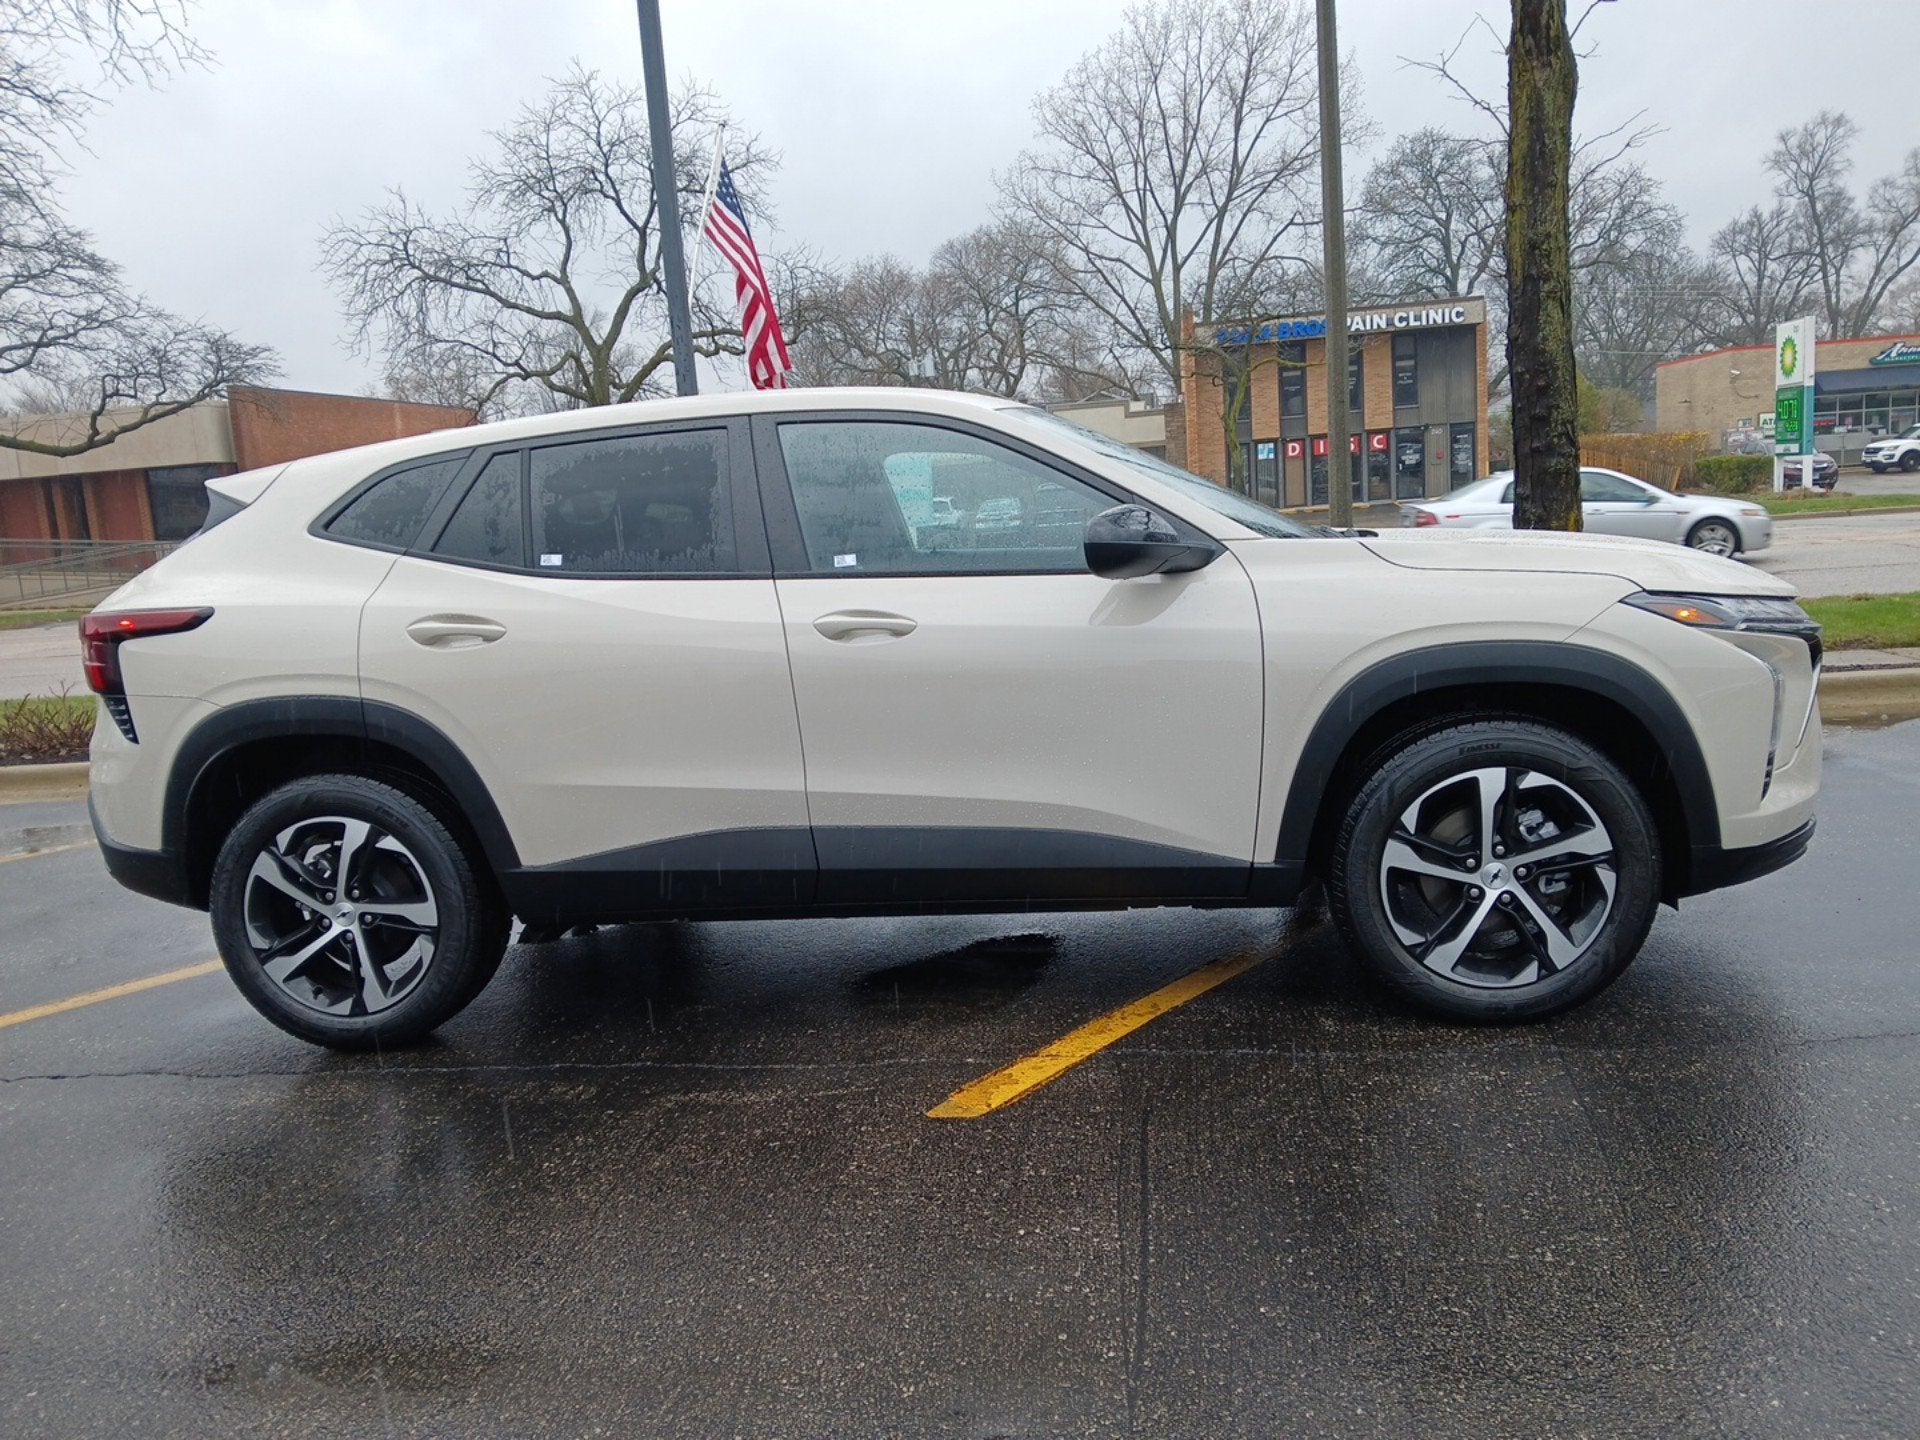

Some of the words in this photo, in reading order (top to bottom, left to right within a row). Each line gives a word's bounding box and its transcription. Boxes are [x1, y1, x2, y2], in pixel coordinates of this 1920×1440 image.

[1347, 312, 1388, 331] AIN
[1394, 306, 1465, 328] CLINIC
[1762, 417, 1776, 425] AT
